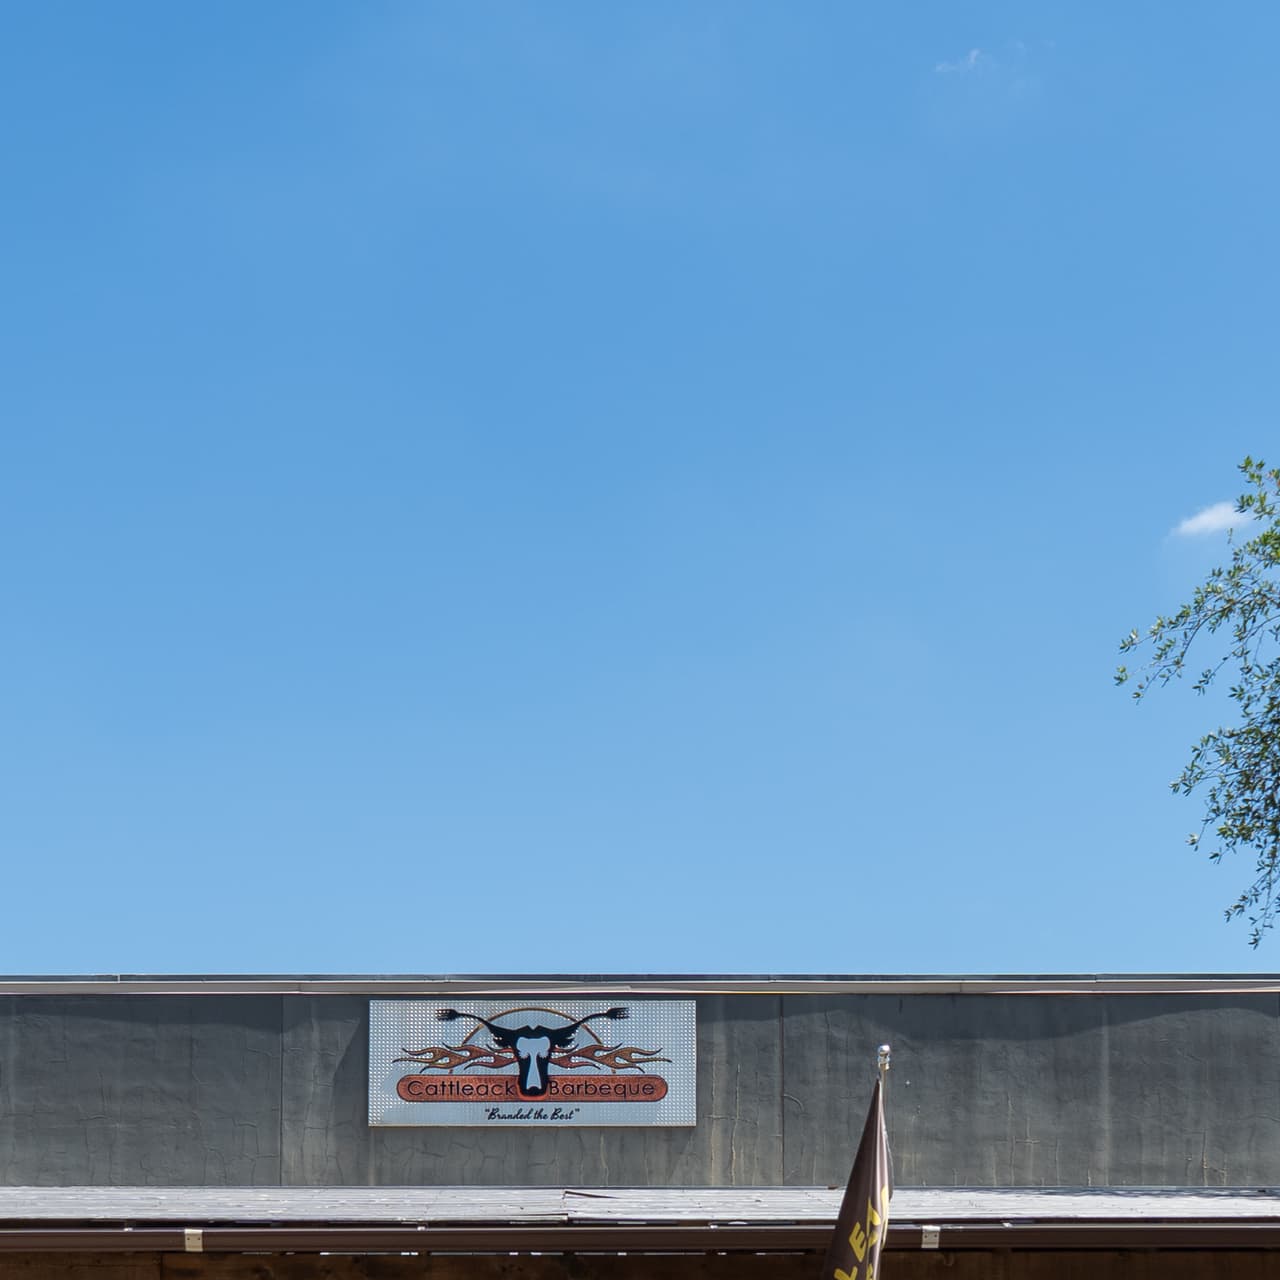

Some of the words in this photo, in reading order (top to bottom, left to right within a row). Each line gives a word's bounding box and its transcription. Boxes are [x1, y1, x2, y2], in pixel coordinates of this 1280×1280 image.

[407, 1080, 516, 1096] Cattleack
[549, 1080, 656, 1098] Barbeque
[533, 1107, 549, 1120] the
